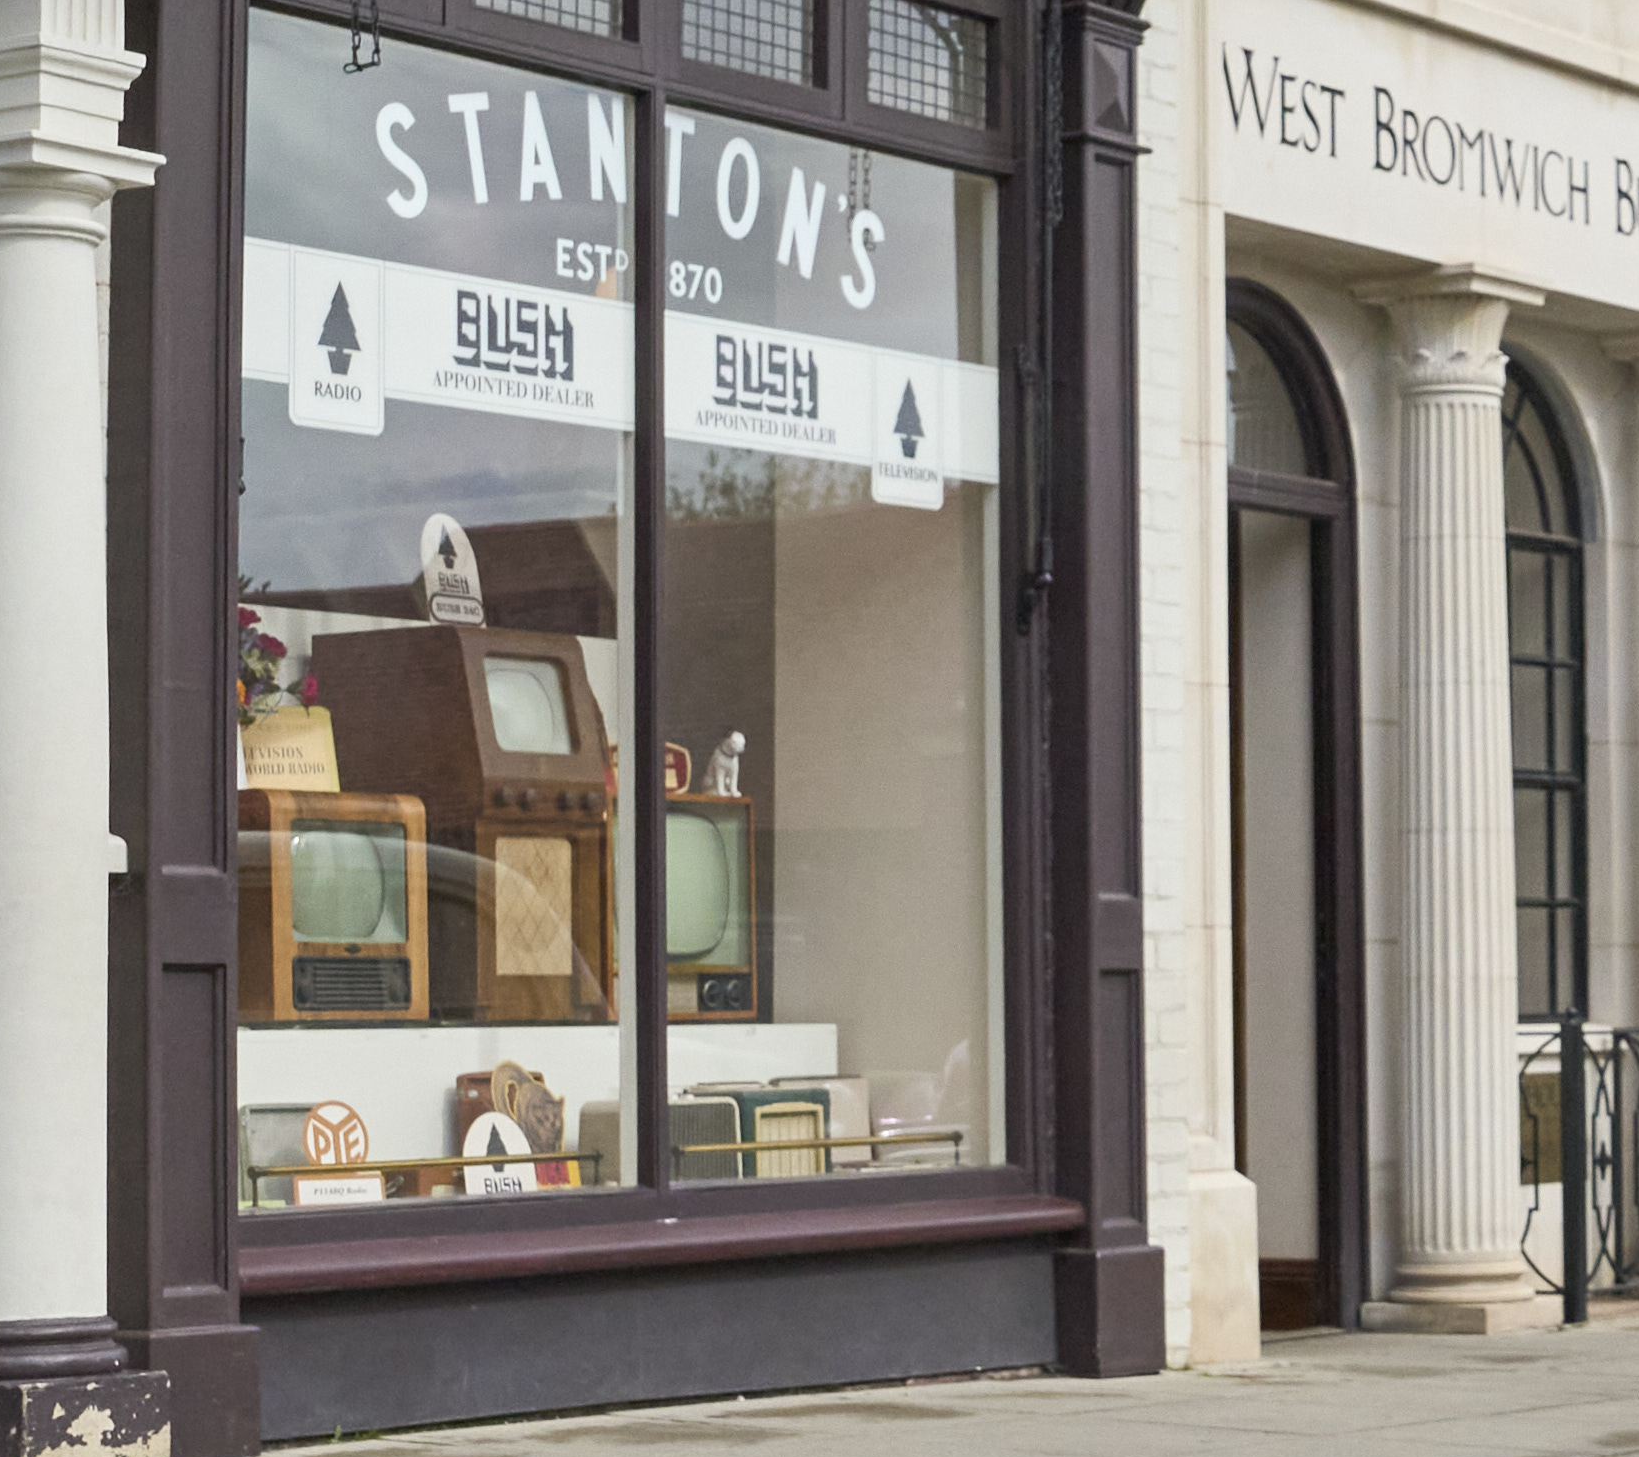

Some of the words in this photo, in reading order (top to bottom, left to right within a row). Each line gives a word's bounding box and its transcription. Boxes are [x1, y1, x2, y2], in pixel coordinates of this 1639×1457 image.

[1222, 41, 1346, 159] WEST
[1372, 85, 1592, 226] BROMWICH
[376, 90, 886, 309] STANTON'S
[669, 260, 723, 304] 870
[452, 289, 574, 382] BUSH
[314, 380, 362, 402] RADIO
[433, 369, 528, 399] APPOINTED
[532, 383, 596, 409] DEALER
[712, 334, 819, 420] BUSH
[695, 409, 781, 436] APPOINTED
[781, 421, 837, 445] DEALER
[878, 462, 939, 484] TELEVISION
[484, 1177, 523, 1195] BUSH
